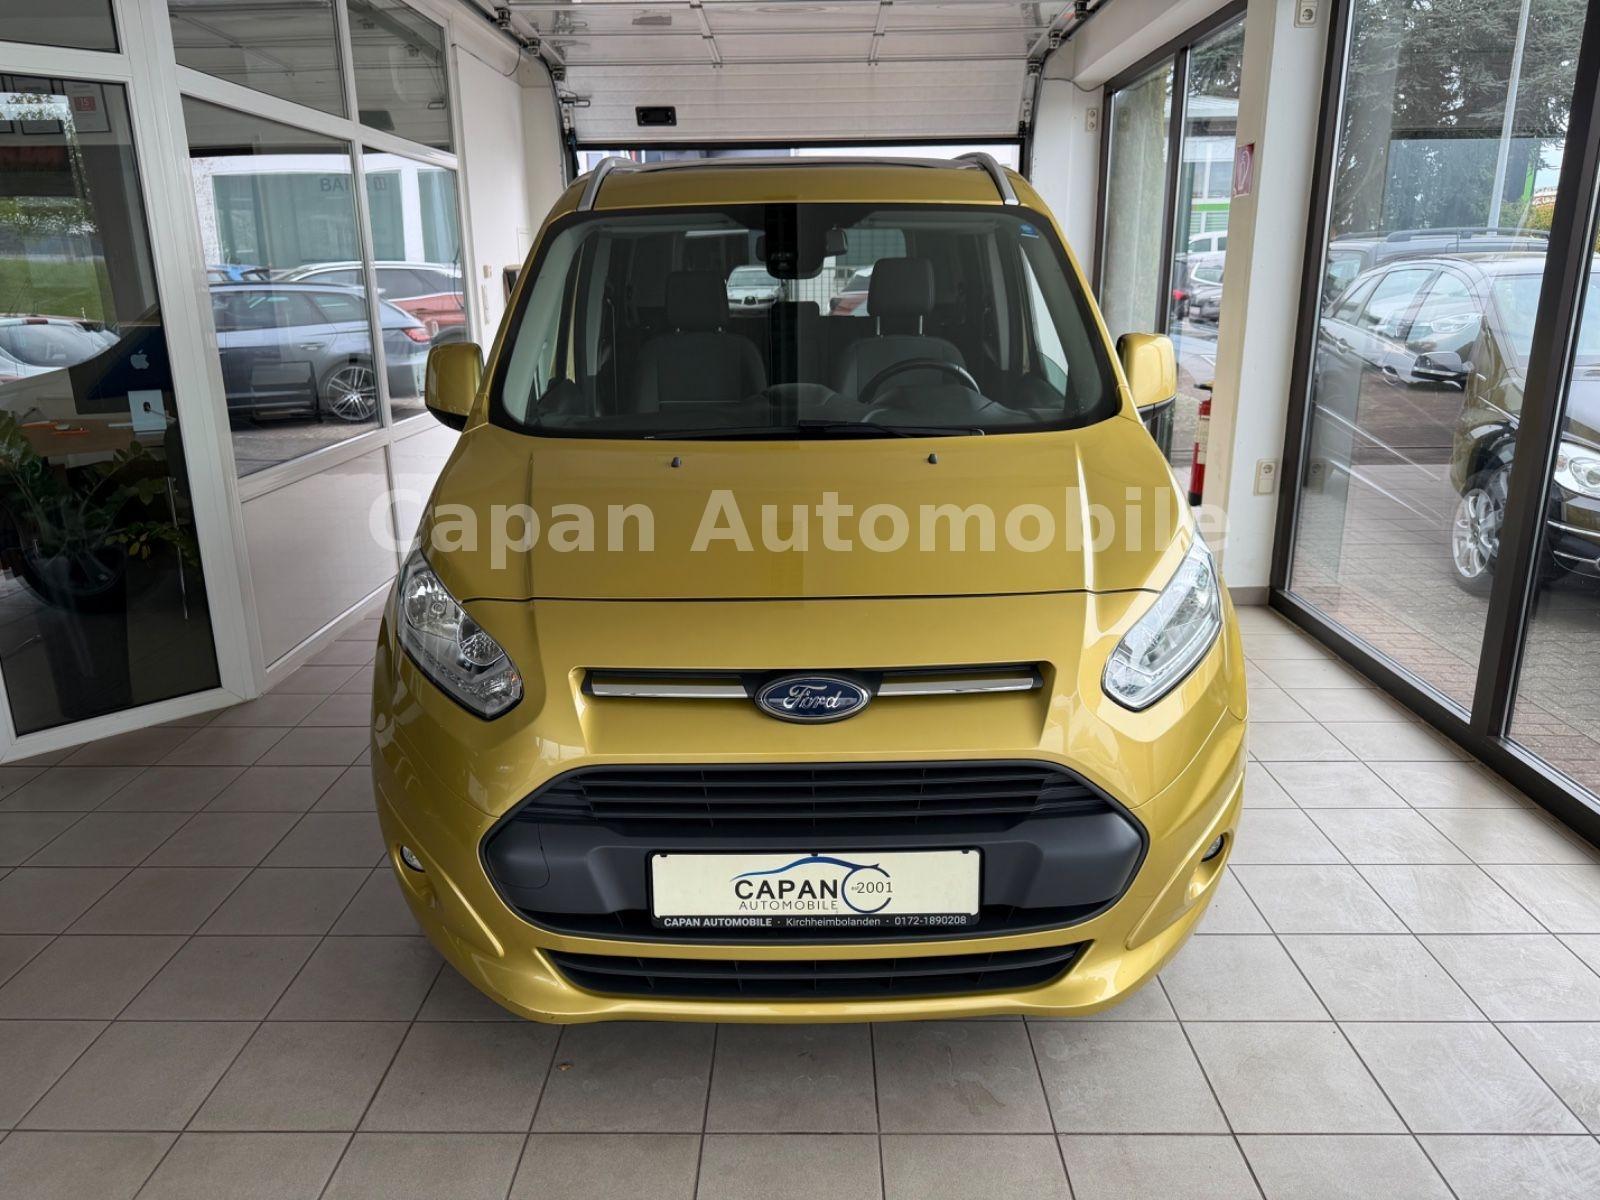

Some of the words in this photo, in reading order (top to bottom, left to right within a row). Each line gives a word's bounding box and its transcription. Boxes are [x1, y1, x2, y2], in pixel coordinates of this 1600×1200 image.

[783, 684, 842, 709] Ford
[734, 879, 838, 900] CAPAN
[856, 881, 893, 894] 2001
[738, 899, 838, 911] AUTOMOBILE
[663, 917, 700, 927] CAPAN
[703, 917, 773, 928] AUTOMOBILE
[785, 917, 881, 927] Kirchheimbolanden
[894, 915, 967, 926] 0172-1890208
